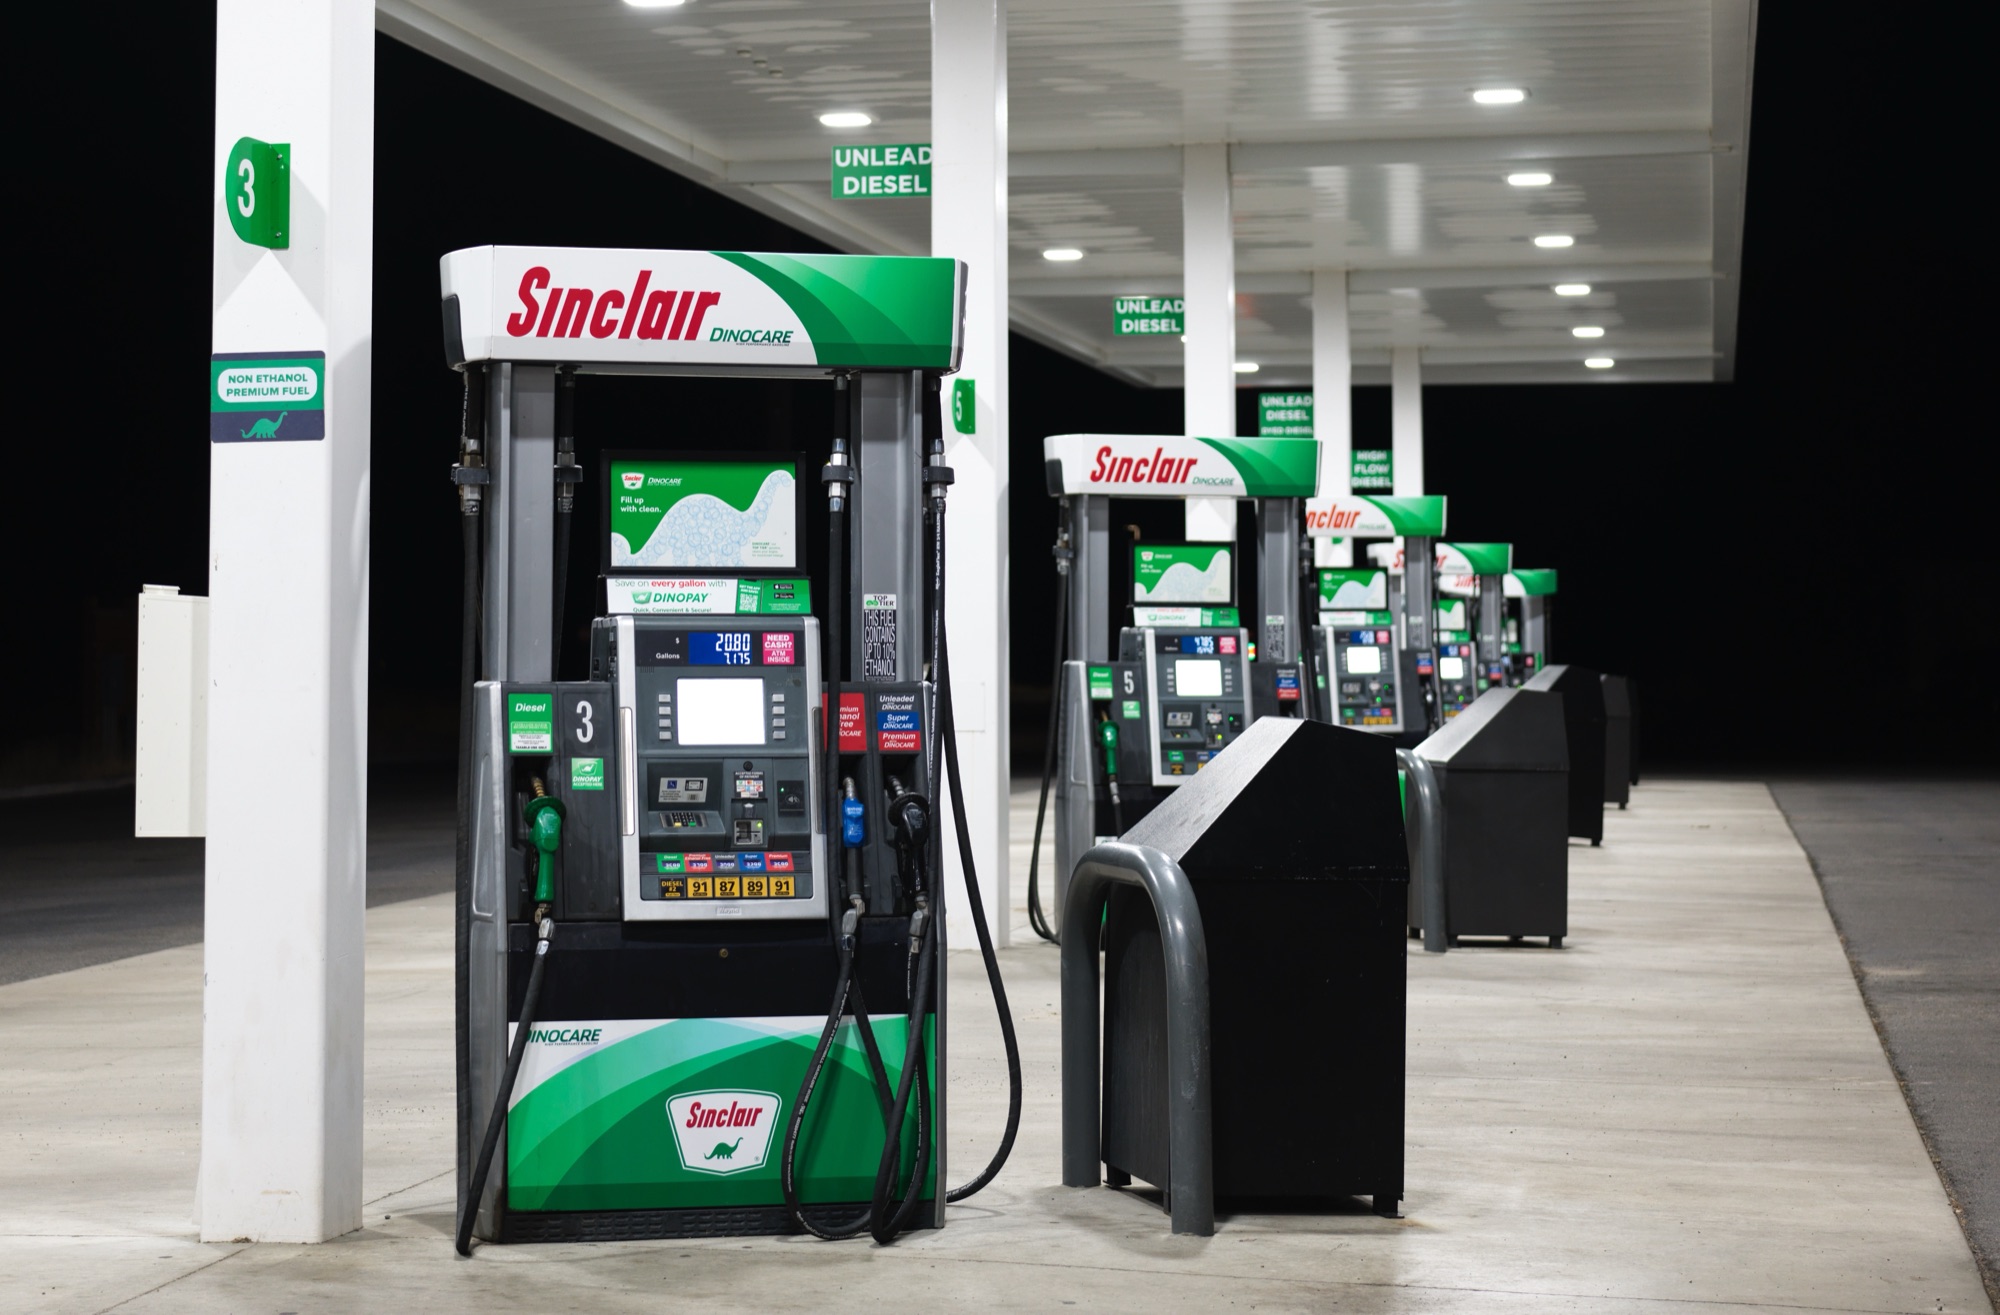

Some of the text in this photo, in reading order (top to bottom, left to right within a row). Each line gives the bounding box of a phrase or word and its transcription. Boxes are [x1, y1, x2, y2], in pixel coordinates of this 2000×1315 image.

[835, 147, 932, 167] UNLEAD
[237, 158, 255, 218] 3
[843, 175, 928, 195] DIESEL
[506, 266, 721, 341] Sinclair
[1115, 299, 1184, 314] UNLEAD
[1121, 318, 1181, 333] DIESEL
[709, 327, 794, 343] DINOCARE
[228, 373, 308, 384] NON ETHANOL
[226, 386, 310, 397] PREMIUM FUEL
[956, 390, 962, 421] 5
[1261, 395, 1313, 408] UNLEAD
[1265, 409, 1310, 421] DIESEL
[1356, 450, 1387, 462] HIGH
[1090, 445, 1198, 484] Sinclair
[1354, 463, 1390, 475] FLOW
[1351, 476, 1392, 488] DIESEL
[639, 505, 661, 513] clean.
[1306, 503, 1361, 528] nclair
[615, 579, 635, 587] Save
[651, 580, 676, 588] every
[678, 579, 706, 588] gallon
[708, 579, 727, 587] with
[653, 593, 708, 603] DINOPAY
[865, 609, 895, 626] THIS FUEL
[864, 626, 896, 643] CONTAINS
[764, 641, 792, 649] CASH?
[864, 643, 896, 659] UP TO 10%
[864, 659, 896, 676] ETHANOL
[1123, 670, 1135, 694] 5
[515, 703, 546, 712] Diesel
[576, 700, 594, 743] 3
[887, 714, 909, 722] Super
[692, 881, 708, 892] 91
[719, 881, 735, 892] 87
[747, 880, 763, 892] 89
[775, 880, 790, 891] 91
[686, 1101, 763, 1129] Sinclair
